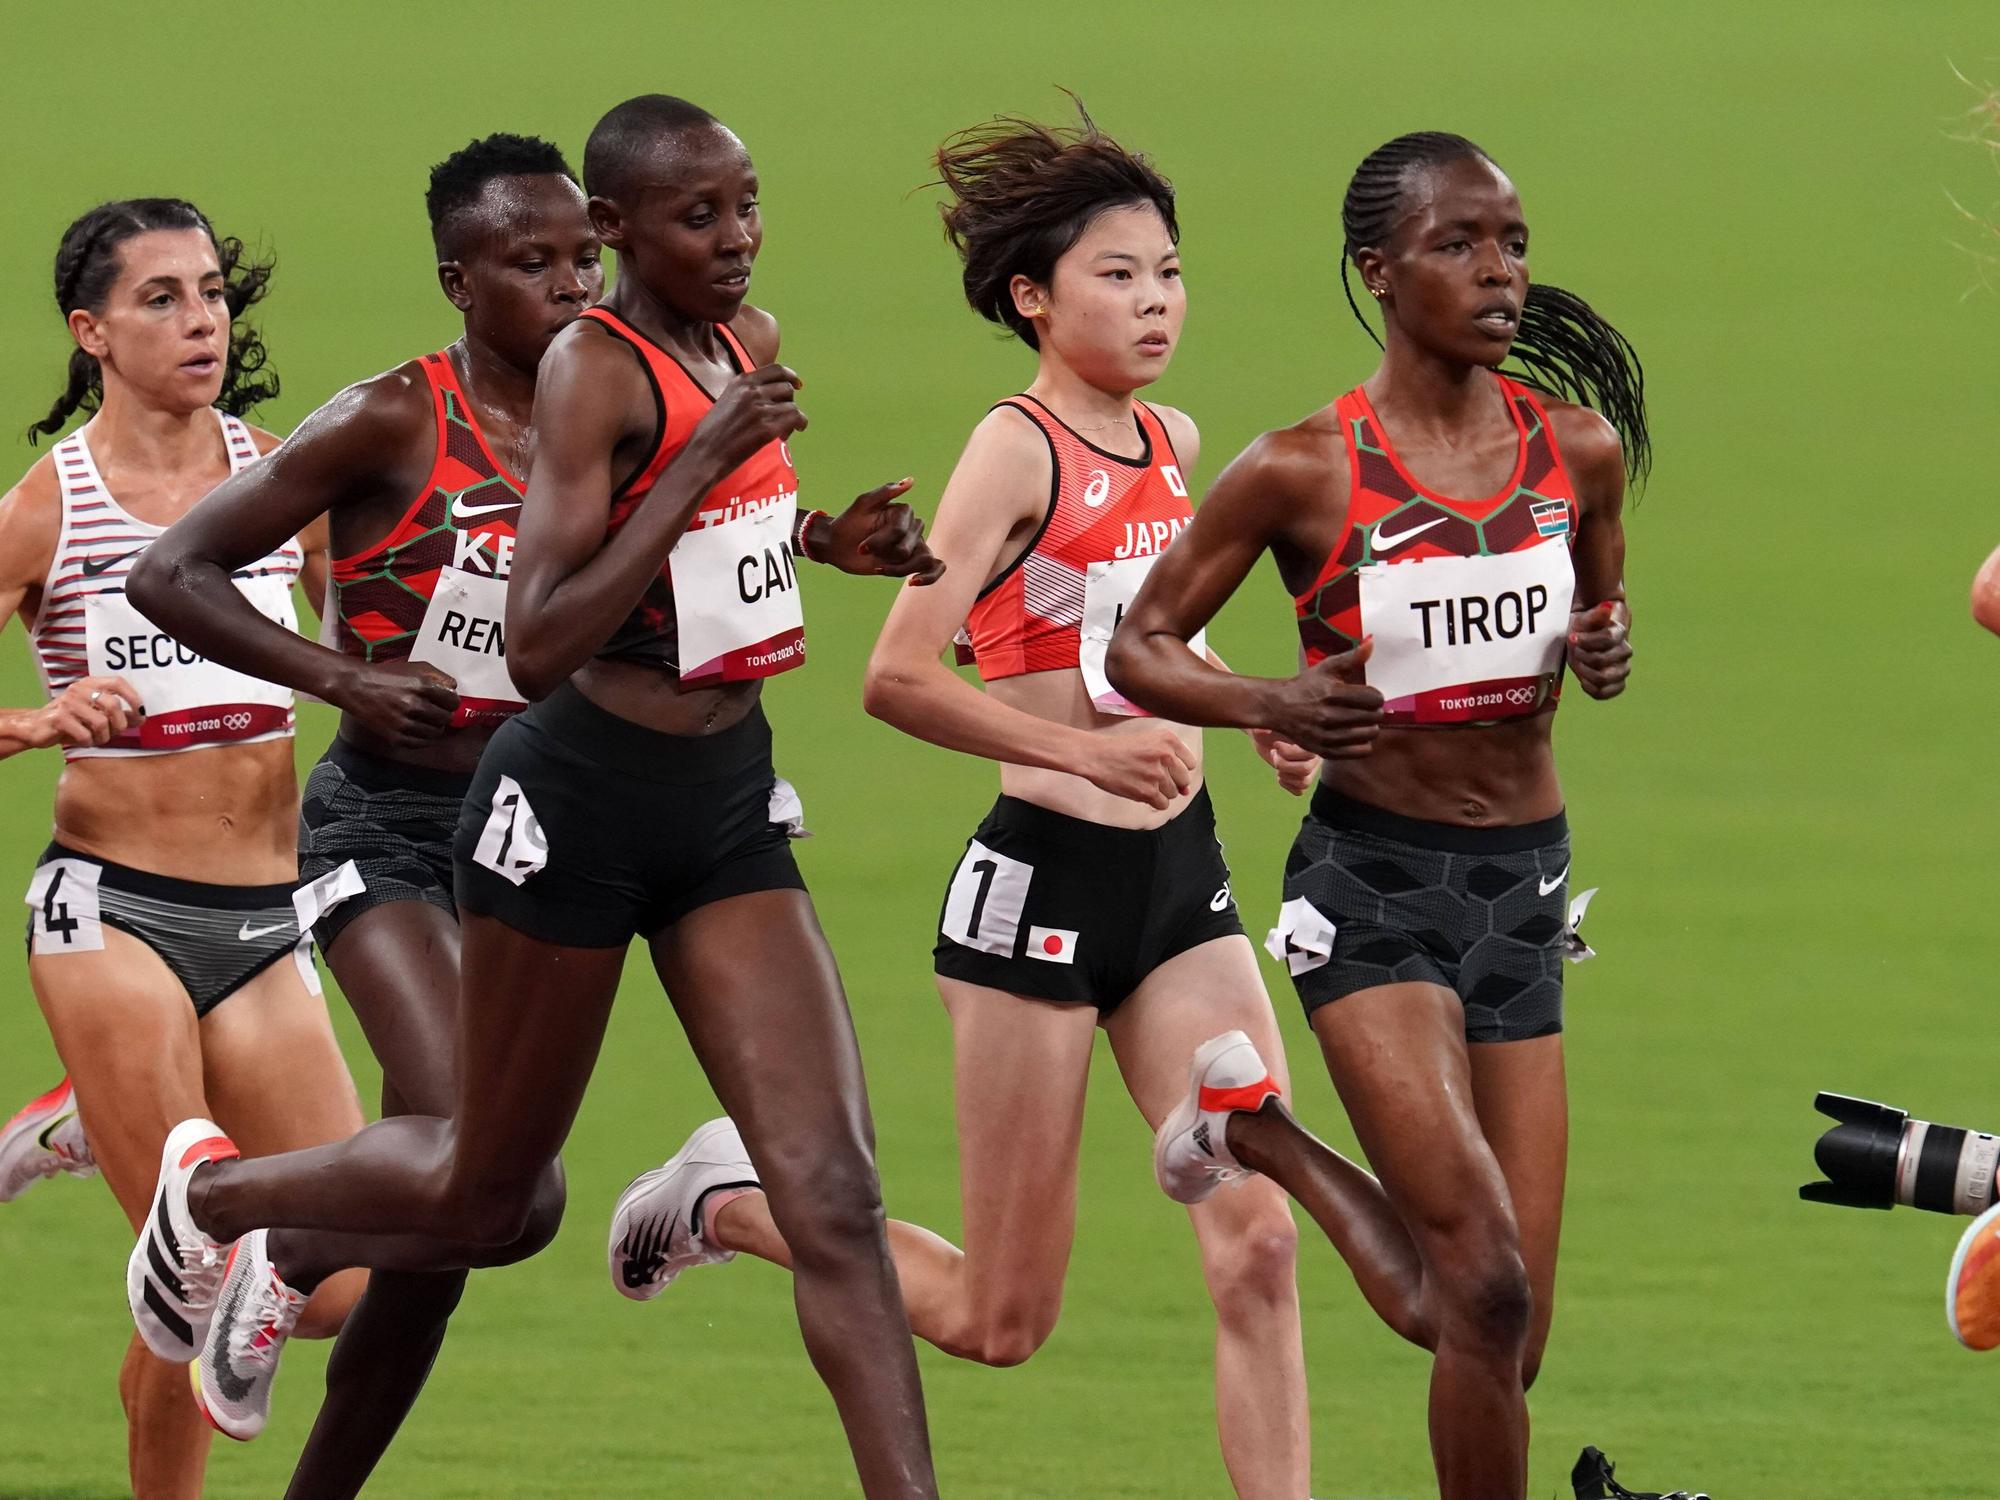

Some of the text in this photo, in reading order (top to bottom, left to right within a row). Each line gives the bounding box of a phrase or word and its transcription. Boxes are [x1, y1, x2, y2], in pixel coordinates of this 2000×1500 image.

[1114, 516, 1194, 559] JAPA
[1410, 584, 1548, 649] TIROP
[745, 645, 795, 668] TOKYO 2020
[1440, 693, 1503, 710] TOKYO 2020
[162, 718, 220, 735] TOKYO 2020
[43, 866, 78, 944] 4
[966, 859, 998, 940] 1
